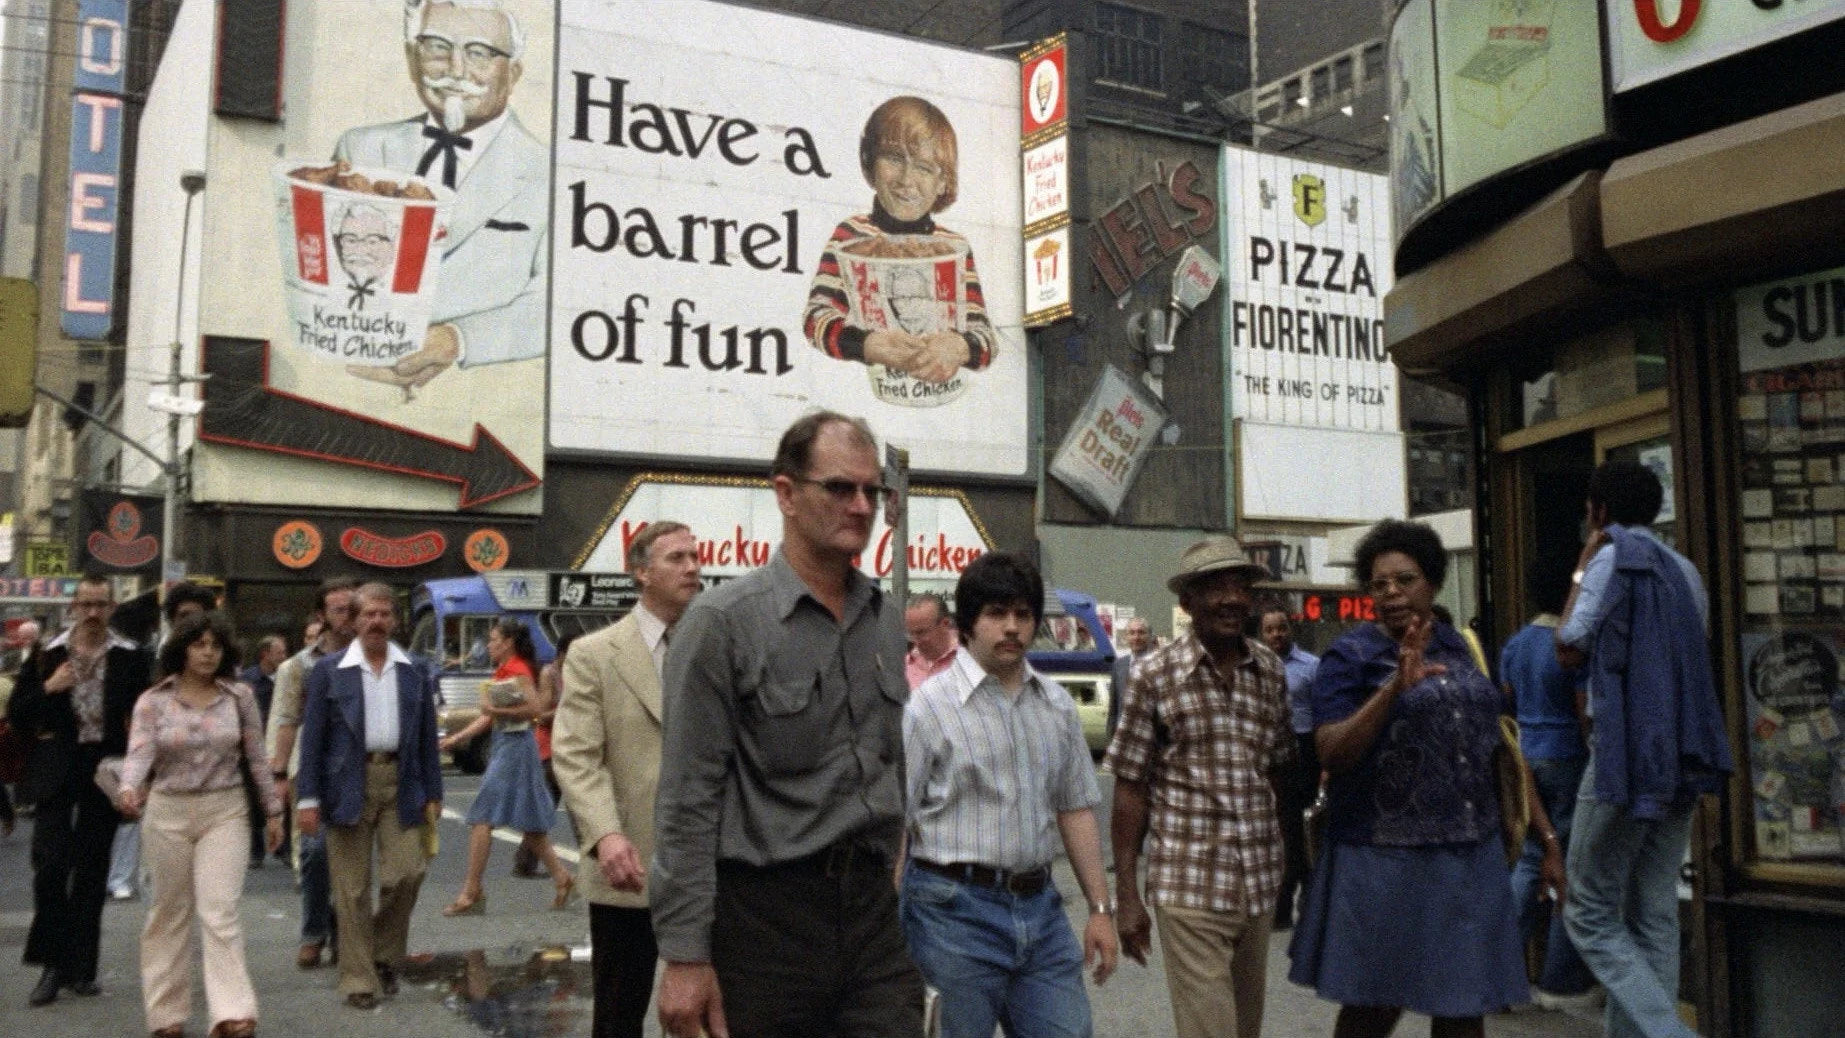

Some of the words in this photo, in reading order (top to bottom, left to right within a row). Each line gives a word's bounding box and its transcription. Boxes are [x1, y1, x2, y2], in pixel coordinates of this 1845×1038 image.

[569, 69, 760, 167] Have
[783, 126, 832, 179] a
[567, 180, 805, 275] barrel
[1302, 184, 1319, 216] F
[1250, 236, 1376, 298] PIZZA
[297, 320, 338, 353] Fried
[343, 335, 414, 360] Chicken
[313, 304, 407, 338] Kentucky
[570, 293, 649, 365] of
[663, 297, 794, 378] fun
[1232, 300, 1389, 363] FIORENTINO
[876, 377, 908, 398] Fried
[912, 378, 962, 398] Chicken
[1278, 378, 1312, 399] KING
[1320, 382, 1340, 402] OF
[1079, 428, 1130, 485] Draft
[1096, 408, 1143, 457] Real
[621, 519, 771, 574] Kucky
